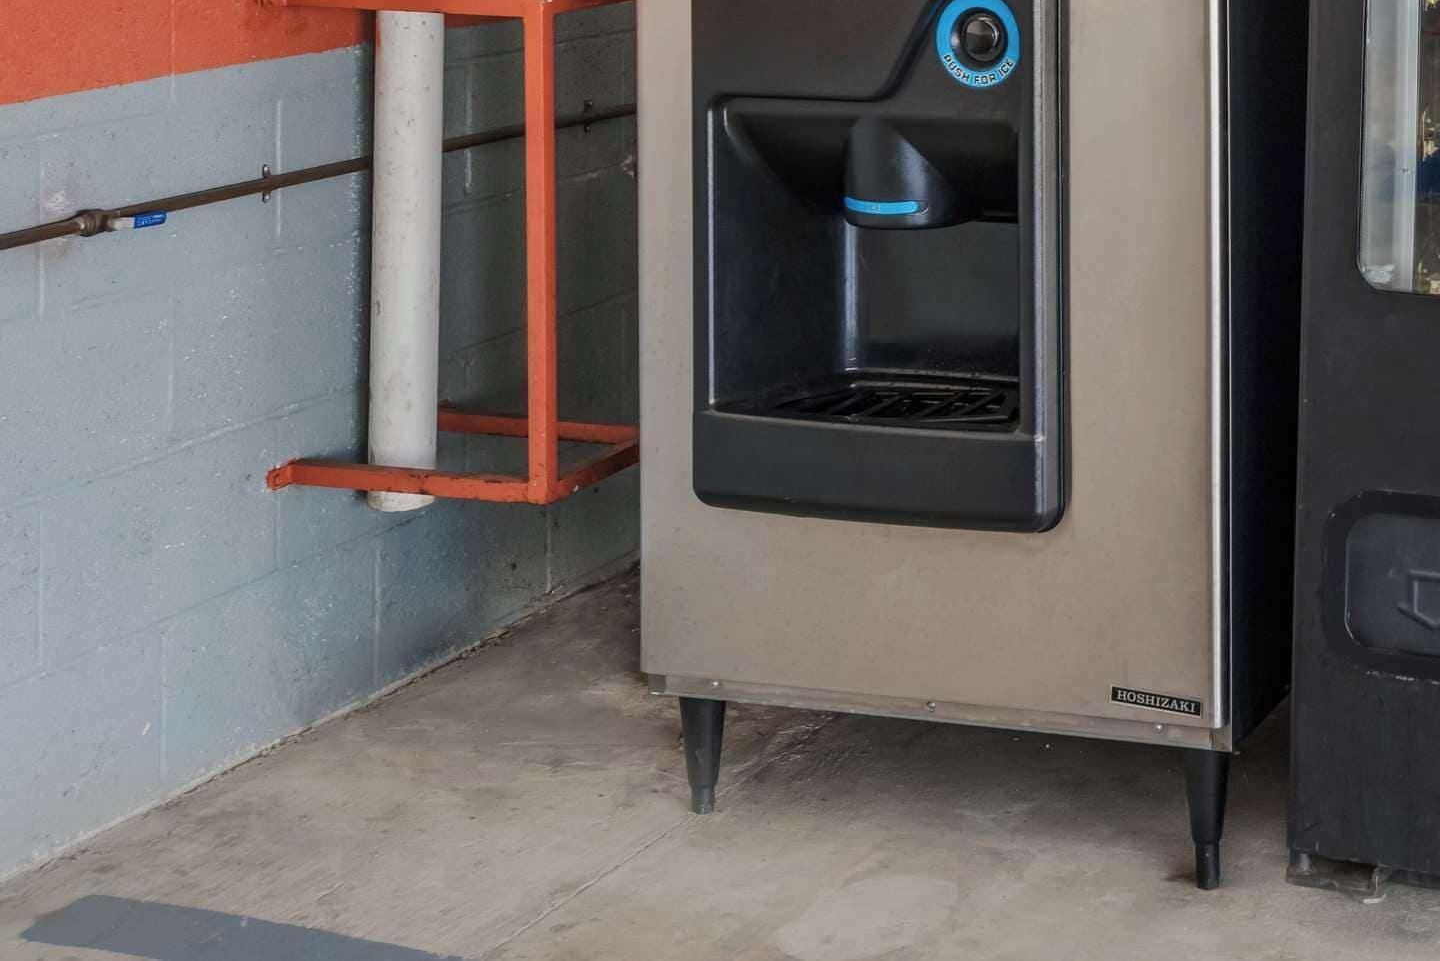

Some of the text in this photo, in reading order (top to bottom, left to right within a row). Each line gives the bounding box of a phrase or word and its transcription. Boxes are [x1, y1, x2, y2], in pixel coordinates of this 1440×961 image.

[943, 54, 1014, 85] PUSH FOR ICE
[1116, 689, 1196, 713] HOSHIZAKI
